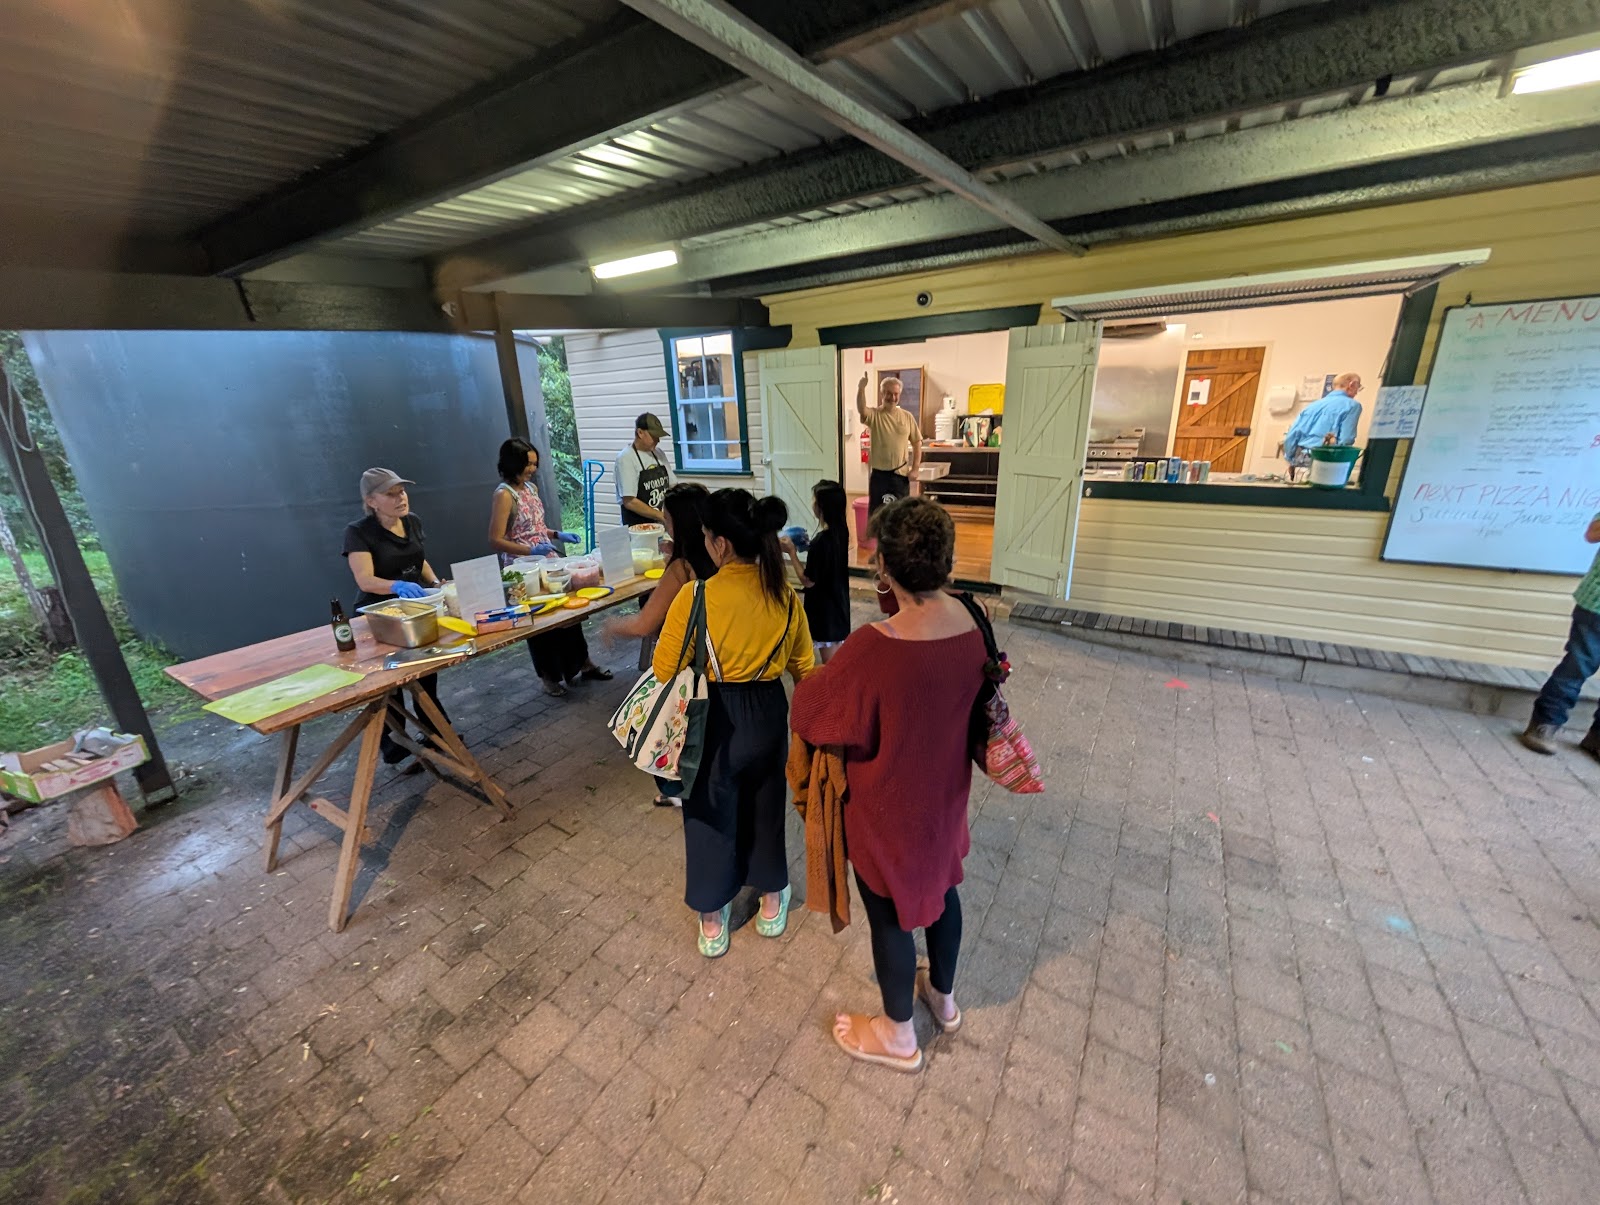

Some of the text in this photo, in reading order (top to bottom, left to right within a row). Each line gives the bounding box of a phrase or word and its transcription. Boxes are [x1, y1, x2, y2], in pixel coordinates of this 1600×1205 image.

[1496, 302, 1600, 326] MENU
[1478, 484, 1550, 507] PIZZA
[1410, 506, 1500, 526] Saturday
[1504, 510, 1553, 528] June
